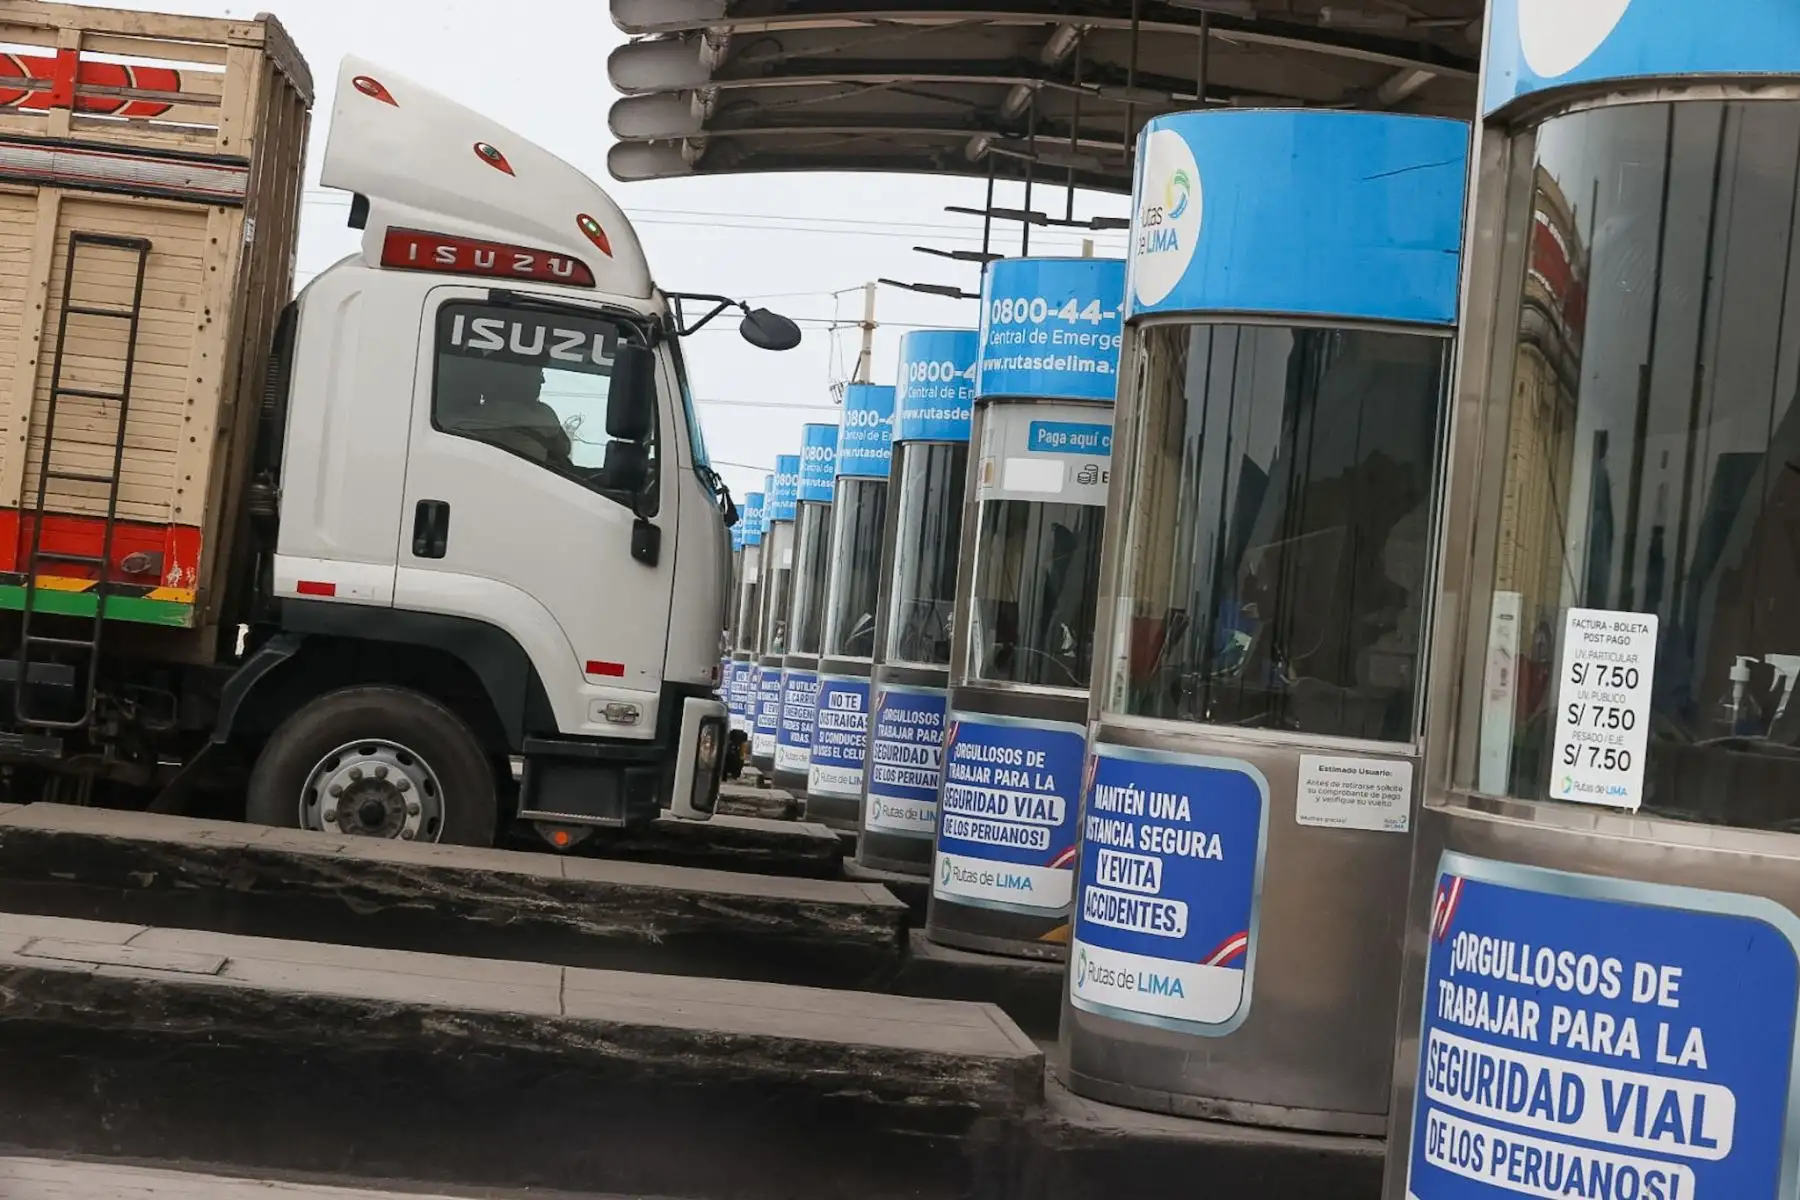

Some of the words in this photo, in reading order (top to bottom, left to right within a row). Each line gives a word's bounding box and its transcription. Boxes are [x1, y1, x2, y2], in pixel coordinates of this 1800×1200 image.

[1147, 228, 1178, 253] LIMA
[409, 243, 574, 277] ISUZU
[990, 328, 1026, 345] Central
[1029, 328, 1048, 345] de
[940, 385, 955, 398] de
[1038, 428, 1066, 445] Paga
[1070, 431, 1098, 449] aquí
[1572, 619, 1607, 630] FACTURA
[1614, 622, 1649, 633] BOLETA
[1584, 633, 1604, 643] POST
[1606, 635, 1631, 646] PAGO
[1588, 650, 1639, 663] PARTICULAR
[1571, 662, 1590, 686] S/
[1596, 664, 1639, 689] 7.50
[831, 694, 843, 707] NO
[845, 695, 857, 708] TE
[1568, 703, 1586, 727] S/
[1592, 706, 1635, 731] 7.50
[1572, 730, 1604, 743] PESADO
[874, 743, 929, 765] SEGURIDAD
[954, 742, 1022, 766] ¡ORGULLOSOS
[1026, 750, 1046, 768] DE
[1563, 743, 1582, 767] S/
[1588, 746, 1631, 771] 7.50
[949, 763, 989, 784] TRABAJAR
[994, 769, 1029, 789] PARA
[1035, 774, 1055, 791] LA
[1318, 765, 1357, 774] Estimado
[944, 786, 1008, 815] SEGURIDAD
[1014, 797, 1059, 821] VIAL
[1095, 782, 1145, 817] MANTÉN
[1149, 792, 1191, 822] UNA
[945, 818, 953, 834] DE
[953, 820, 969, 837] LOS
[971, 822, 1044, 847] PERUANOS!
[1139, 824, 1223, 861] SEGURA
[953, 865, 978, 884] Rutas
[979, 871, 994, 886] de
[996, 873, 1033, 891] LIMA
[1101, 852, 1109, 880] Y
[1109, 854, 1157, 889] EVITA
[1086, 890, 1182, 934] ACCIDENTES.
[1088, 961, 1115, 985] Rutas
[1117, 968, 1135, 990] de
[1138, 972, 1184, 999] LIMA
[1450, 930, 1623, 1000] ¡ORGULLOSOS
[1632, 961, 1683, 1008] DE
[1437, 979, 1540, 1042] TRABAJAR
[1550, 1005, 1641, 1060] PARA
[1656, 1023, 1708, 1070] LA
[1428, 1037, 1586, 1125] SEGURIDAD
[1601, 1078, 1718, 1149] VIAL
[1429, 1118, 1447, 1160] DE
[1449, 1125, 1484, 1173] LOS
